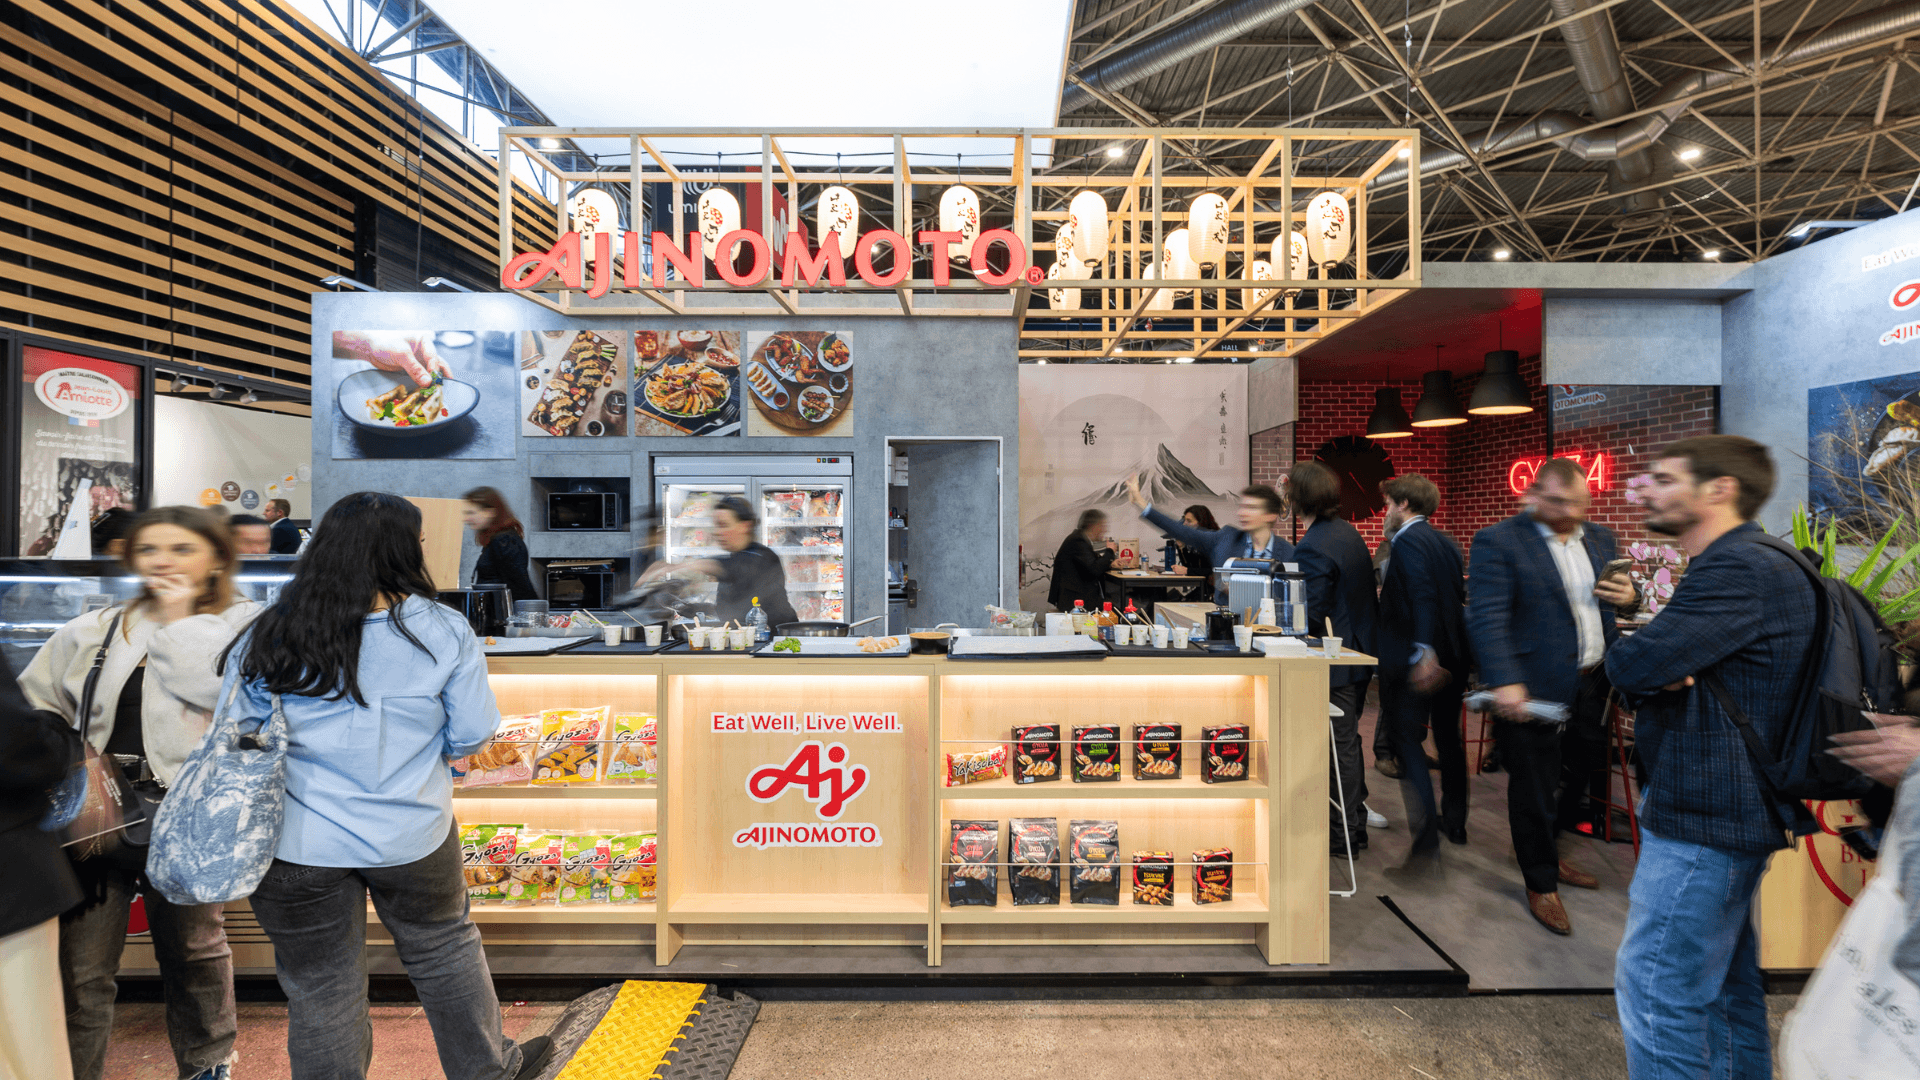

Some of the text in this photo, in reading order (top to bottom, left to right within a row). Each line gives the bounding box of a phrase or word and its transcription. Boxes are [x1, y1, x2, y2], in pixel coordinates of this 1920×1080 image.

[713, 715, 901, 732] Eat Well, Live Well.
[953, 755, 1001, 776] Yakisoba
[736, 827, 876, 846] AJINOMOTO
[516, 851, 557, 870] Gyoza
